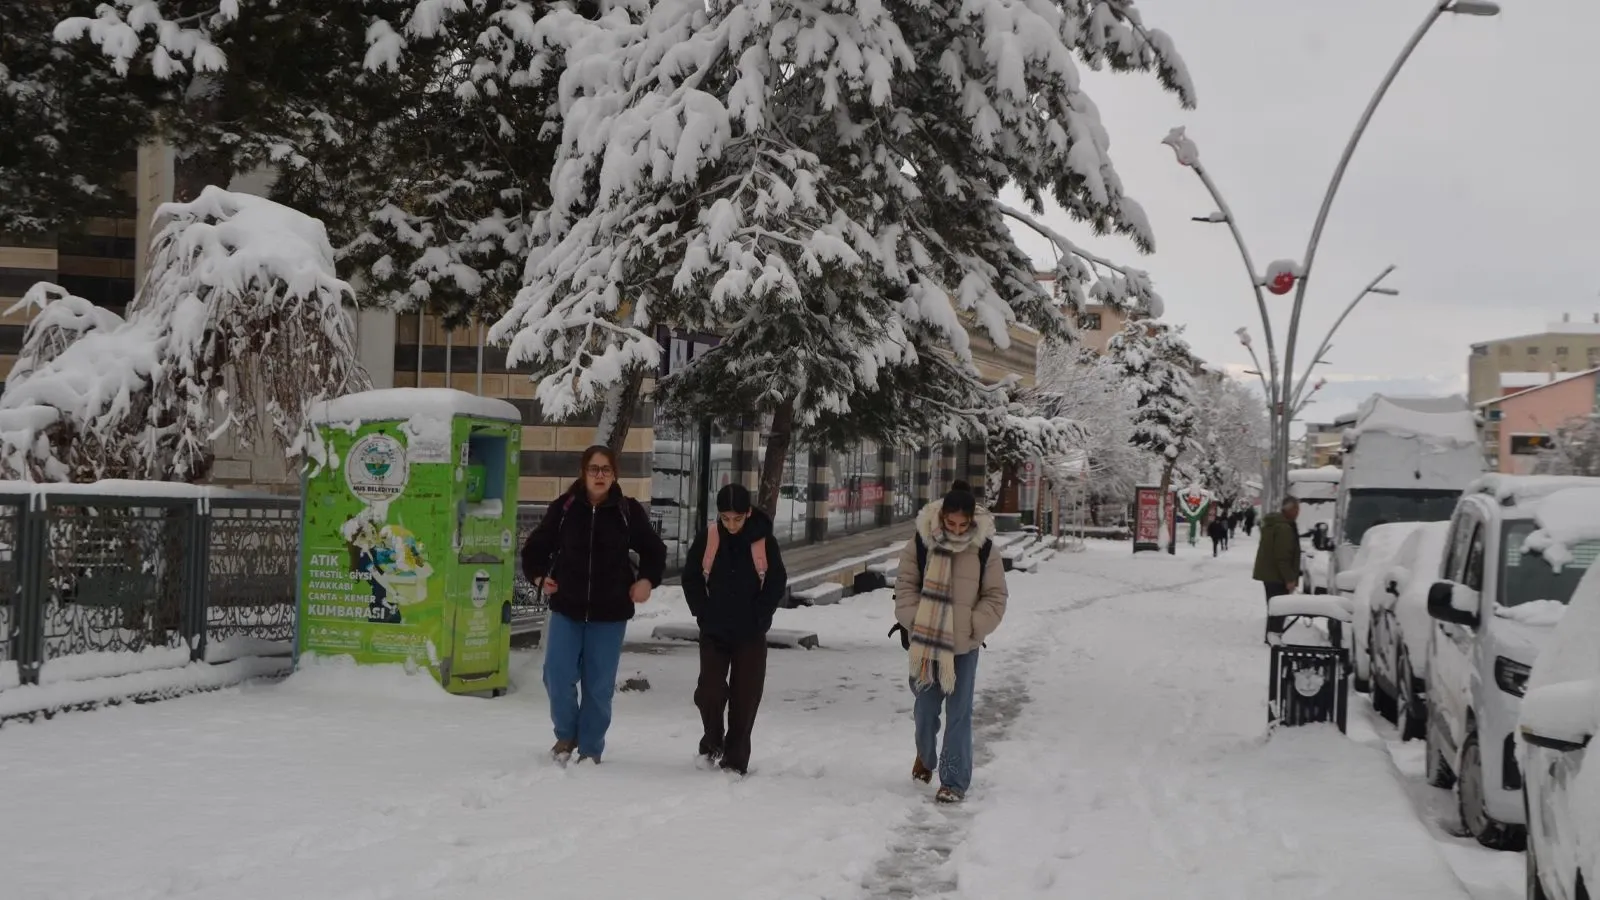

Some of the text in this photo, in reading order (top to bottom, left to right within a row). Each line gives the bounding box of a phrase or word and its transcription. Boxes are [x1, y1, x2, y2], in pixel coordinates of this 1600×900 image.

[310, 554, 338, 566] ATIK
[309, 581, 353, 591] AYAKKABI
[344, 594, 376, 603] KEMER
[308, 604, 385, 619] KUMBARASI
